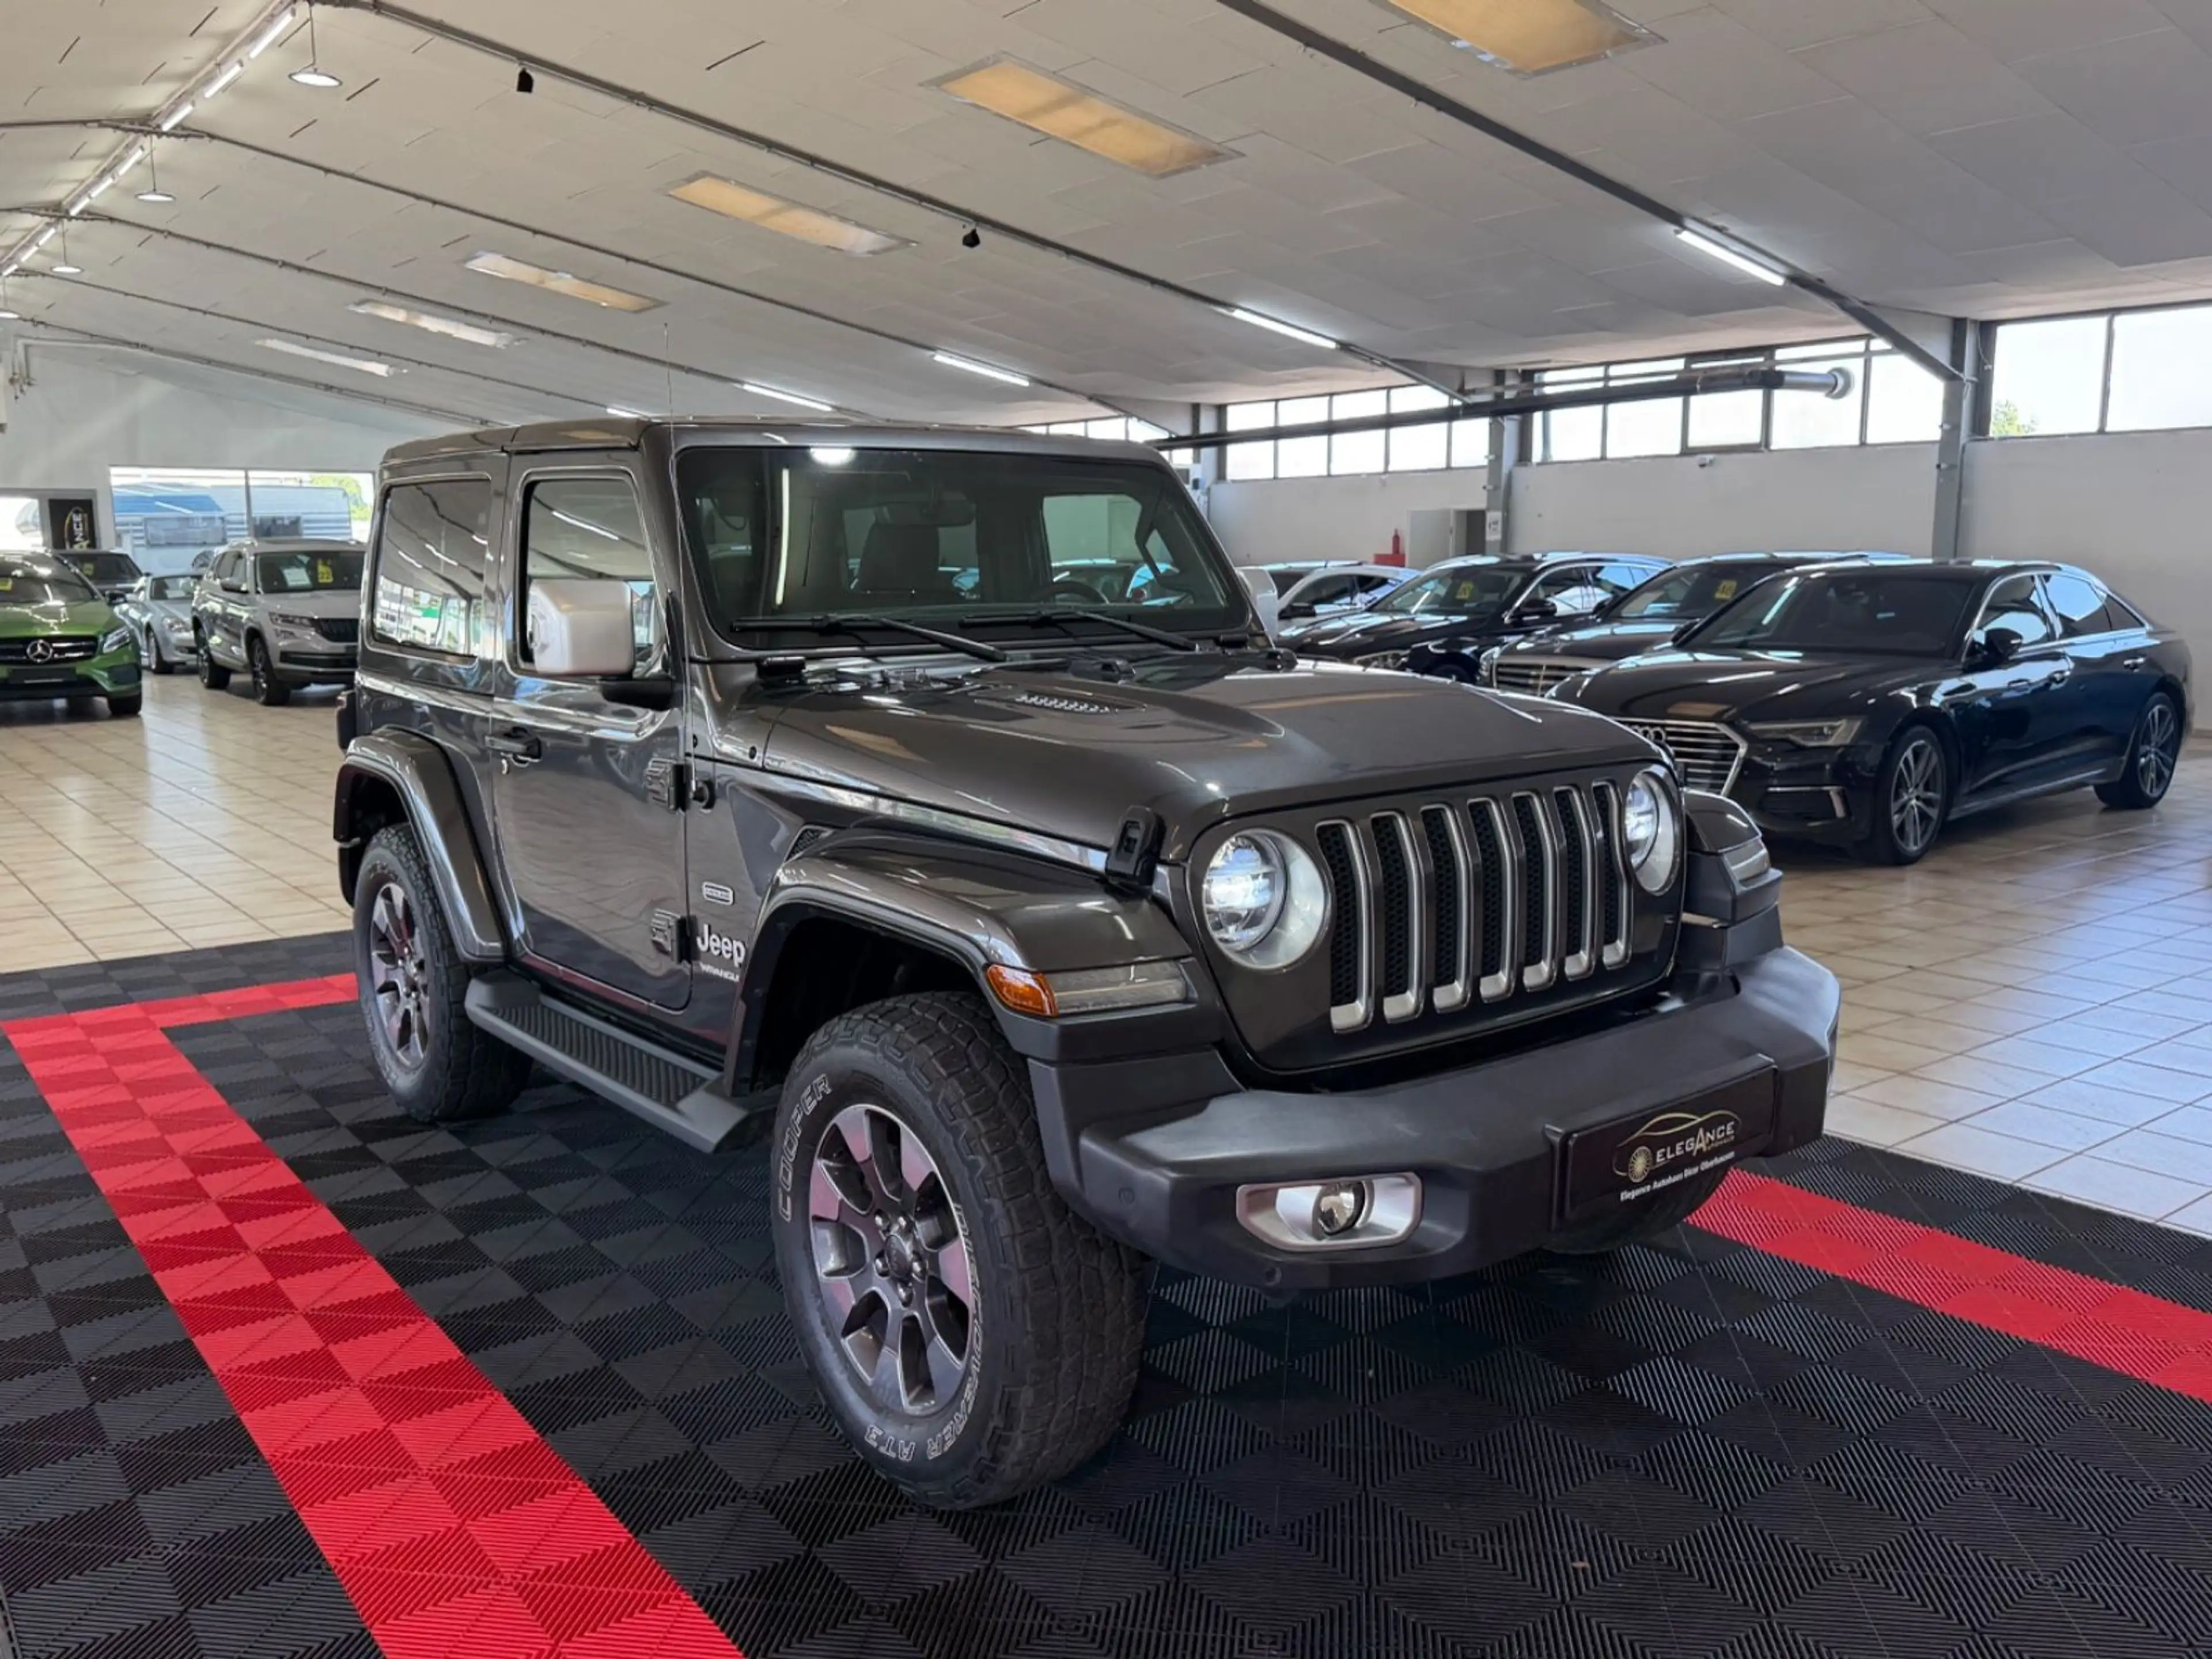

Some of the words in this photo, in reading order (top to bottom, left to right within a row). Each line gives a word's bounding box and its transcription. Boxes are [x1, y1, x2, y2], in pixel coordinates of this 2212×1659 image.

[696, 923, 745, 968] Jeep
[779, 1073, 832, 1222] COOPER
[1656, 1121, 1734, 1163] ELEGANCE
[865, 1424, 916, 1462] AT3
